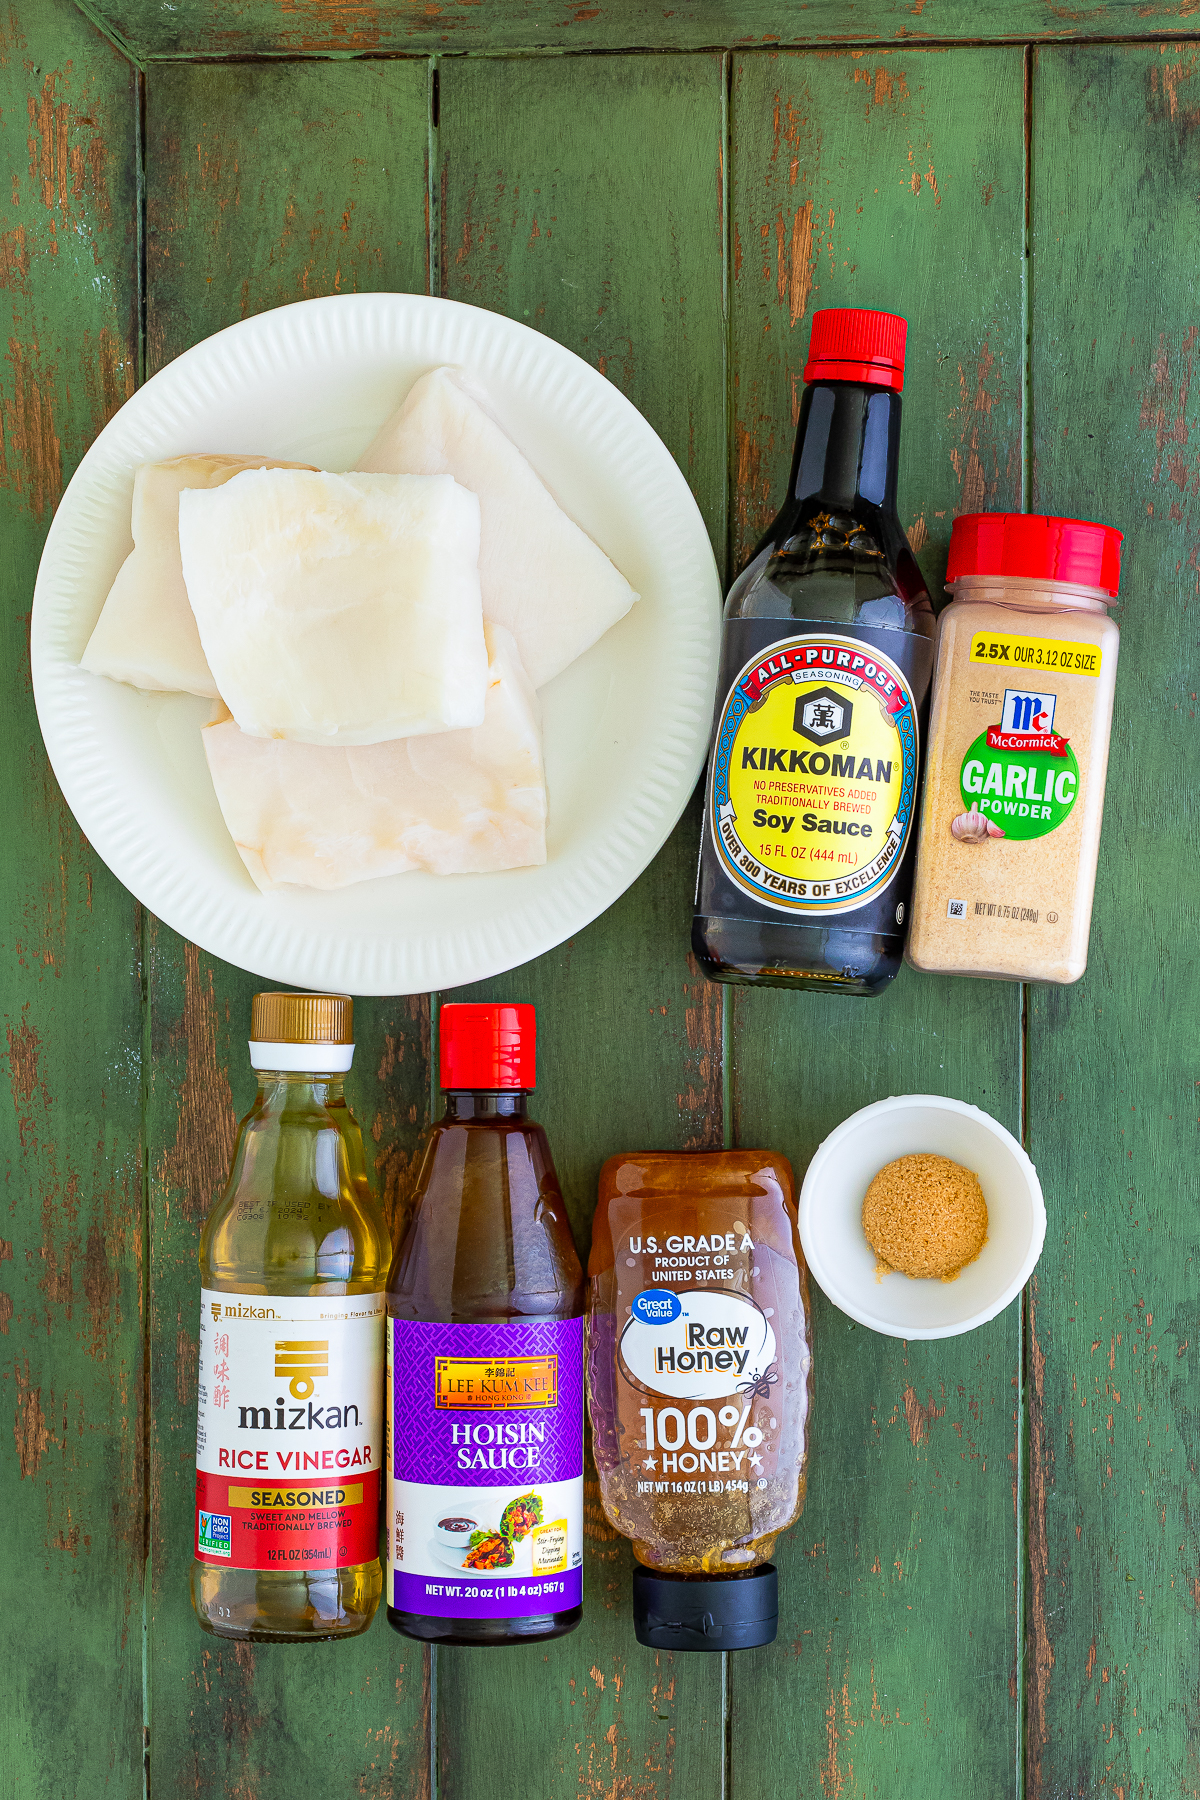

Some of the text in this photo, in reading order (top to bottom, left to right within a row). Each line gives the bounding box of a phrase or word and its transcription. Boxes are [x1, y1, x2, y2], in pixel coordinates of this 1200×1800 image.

[976, 642, 1096, 670] 2.5X OUR 3.12 OZ SIZE
[757, 649, 897, 696] ALL-PURPOSE
[795, 671, 860, 685] SEASONING
[982, 691, 999, 699] TASTE
[990, 733, 1060, 749] McCormick
[741, 746, 892, 783] KIKKOMAN
[753, 780, 877, 801] NO PRESERVATIVES ADDED
[962, 760, 1076, 804] GARLIC
[756, 794, 871, 814] TRADITIONALLY BREWED
[980, 799, 1052, 820] POWDER
[753, 809, 873, 837] Soy Sauce
[722, 822, 898, 897] OVER 300 YEARS OF EXCELLENCE
[759, 844, 858, 866] 15 FL OZ (444 mL)
[975, 902, 986, 915] NET
[987, 904, 997, 916] WT
[629, 1233, 755, 1254] U.S. GRADE A
[655, 1255, 729, 1268] PRODUCT OF
[652, 1269, 734, 1282] UNITED STATES
[224, 1303, 275, 1319] mizkan
[637, 1298, 673, 1318] Great Value
[685, 1323, 749, 1350] Raw
[655, 1347, 750, 1377] Honey
[447, 1377, 549, 1393] LEE KUM KEE
[238, 1397, 359, 1430] mizkan
[451, 1422, 545, 1444] HOISIN
[640, 1405, 763, 1451] 100%
[218, 1445, 372, 1470] RICE VINEGAR
[457, 1447, 540, 1470] SAUCE
[662, 1451, 746, 1473] HONEY
[637, 1480, 748, 1494] NET WT 16 OZ (1 LB) 454g
[250, 1490, 345, 1507] SEASONED
[212, 1517, 229, 1526] NON
[242, 1519, 352, 1531] TRADITIONALLY BREWED
[250, 1510, 345, 1521] SWEET AND MELLOW
[212, 1525, 229, 1533] GMO
[200, 1537, 229, 1549] ERIFIED
[542, 1546, 560, 1555] Dipping
[267, 1547, 332, 1560] 12 FL OZ (354mL)
[425, 1582, 564, 1600] NET WT. 20 oz (1 lb 4 oz) 567 g
